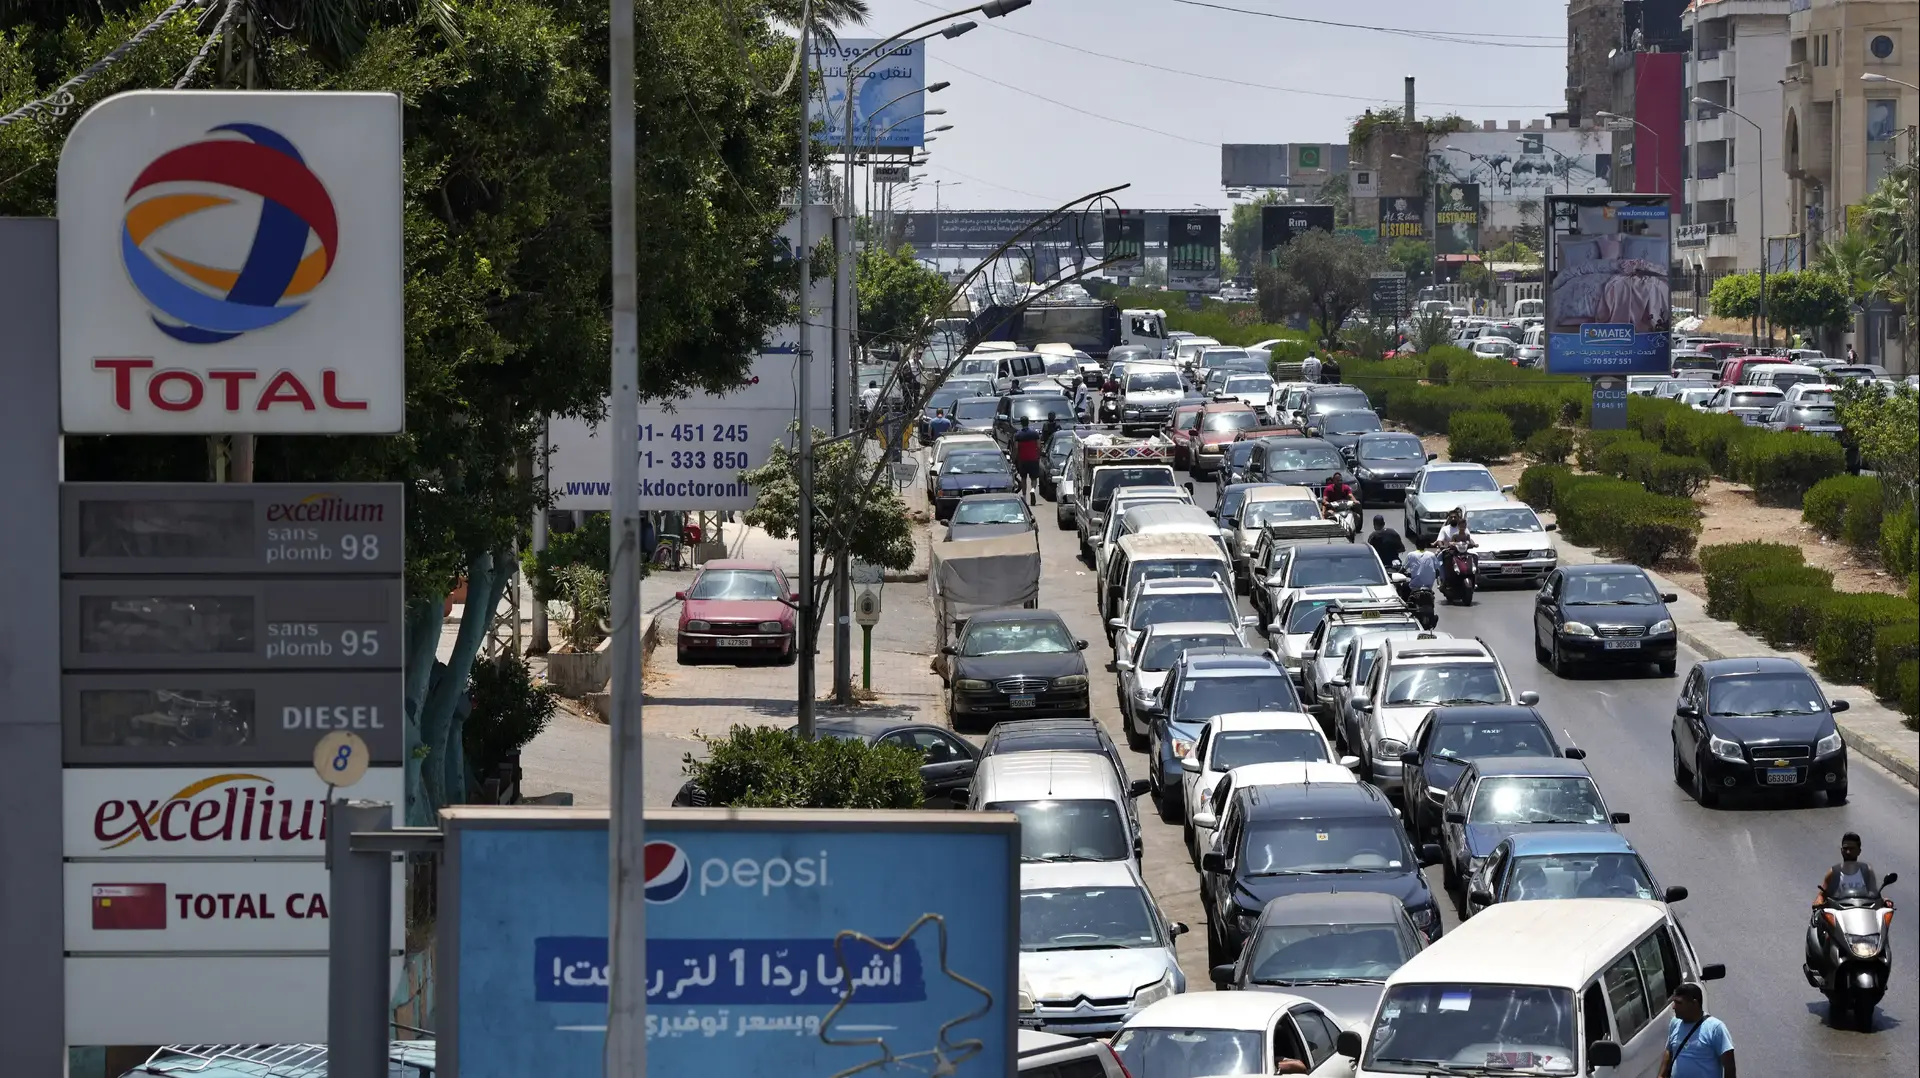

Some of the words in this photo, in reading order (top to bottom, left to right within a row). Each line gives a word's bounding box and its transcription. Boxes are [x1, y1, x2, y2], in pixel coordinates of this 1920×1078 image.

[880, 66, 912, 80] لنقل
[1288, 217, 1307, 227] Rim
[1617, 209, 1665, 217] www.fomatex.com
[1187, 223, 1202, 231] Rim
[1381, 222, 1423, 237] RSTOCAFE
[1584, 328, 1632, 338] FOMATEX
[94, 359, 368, 412] TOTAL
[671, 424, 704, 441] 451
[713, 424, 748, 442] 245
[671, 452, 706, 469] 333
[713, 452, 748, 469] 850
[266, 498, 384, 522] excellium
[267, 528, 318, 541] sans
[266, 545, 332, 564] plomb
[341, 534, 379, 560] 98
[267, 623, 318, 636] sans
[266, 640, 332, 659] plomb
[341, 630, 379, 656] 95
[282, 706, 384, 729] DIESEL
[333, 744, 352, 771] 8
[94, 785, 326, 842] excelliu
[700, 849, 828, 897] pepsi
[175, 893, 275, 919] TOTAL
[666, 953, 717, 999] لتر
[729, 947, 745, 986] 1
